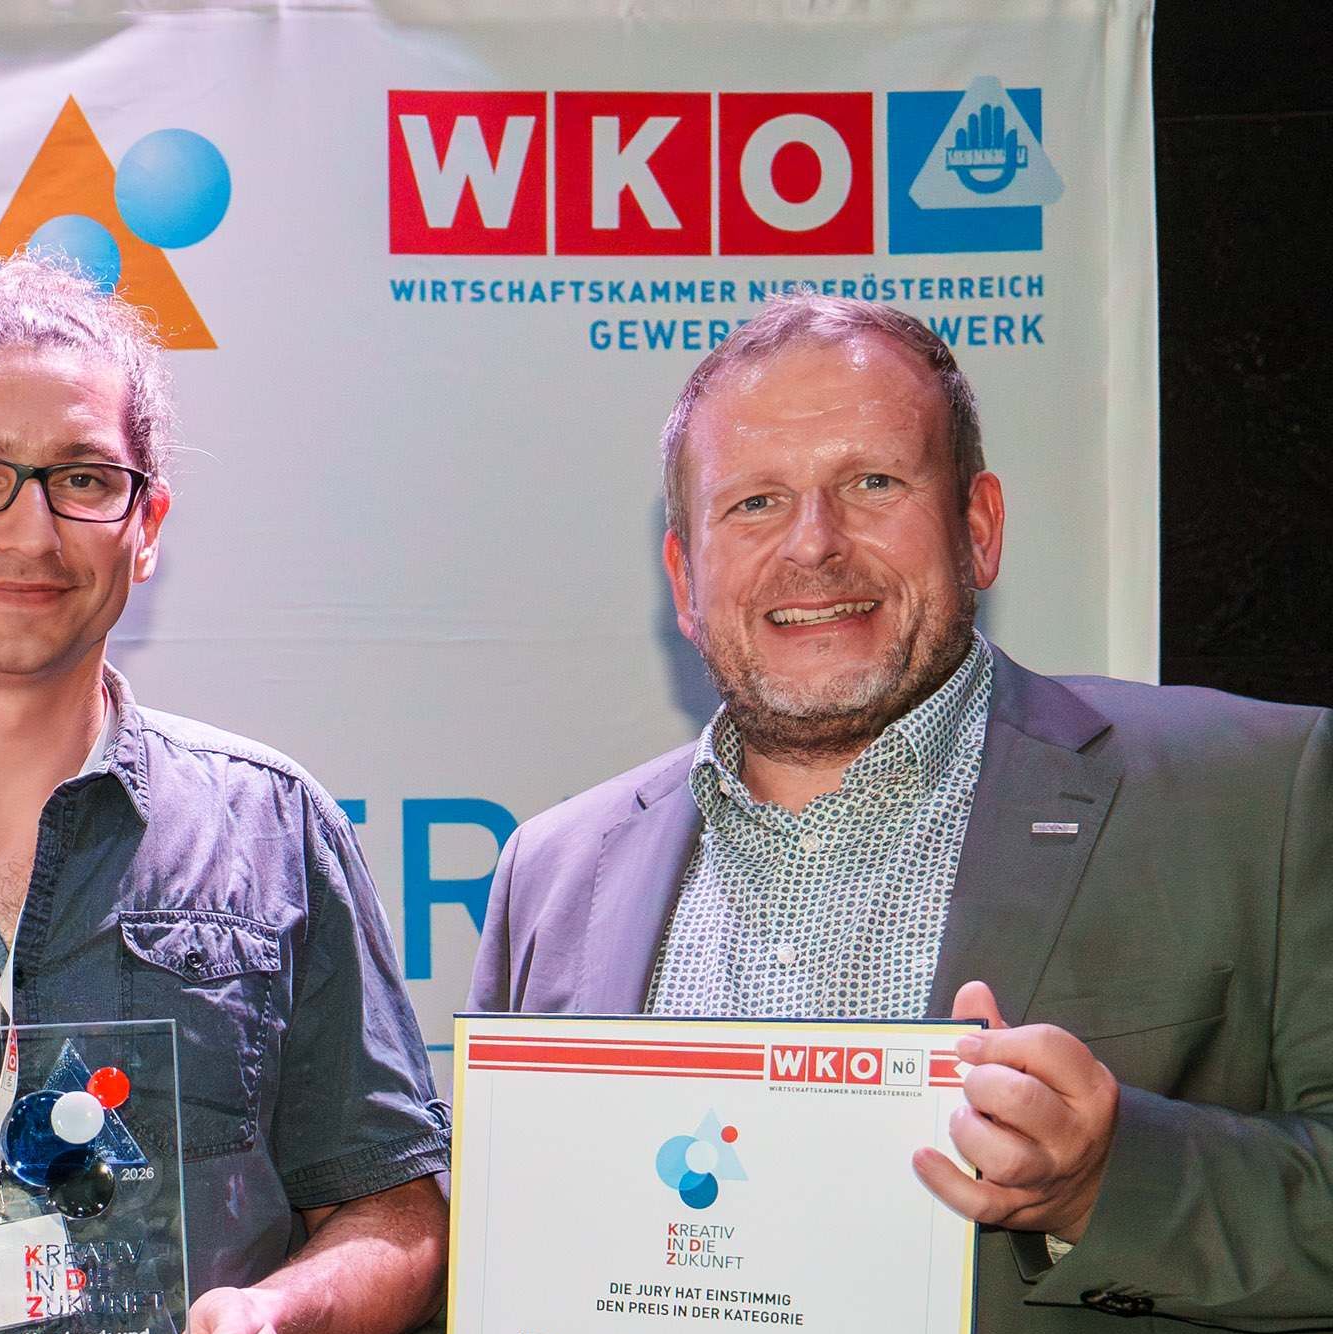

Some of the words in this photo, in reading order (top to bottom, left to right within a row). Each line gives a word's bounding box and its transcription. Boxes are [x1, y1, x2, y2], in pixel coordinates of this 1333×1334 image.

[398, 112, 853, 232] WKO
[390, 279, 735, 303] WIRTSCHAFTSKAMMER
[773, 1050, 878, 1080] WKO
[893, 1057, 915, 1075] NÖ
[769, 1086, 848, 1094] WIRTSCHAFTSKAMMER
[121, 1167, 154, 1181] 2026
[668, 1223, 734, 1239] KREATIV
[25, 1239, 144, 1267] KREATIV
[667, 1238, 684, 1251] IN
[689, 1239, 716, 1253] DIE
[666, 1252, 744, 1270] ZUKUNFT
[26, 1270, 54, 1292] IN
[66, 1268, 111, 1290] DIE
[26, 1290, 164, 1318] ZUKUNFT
[610, 1282, 632, 1295] DIE
[635, 1285, 672, 1298] JURY
[675, 1287, 702, 1300] HAT
[706, 1289, 791, 1306] EINSTIMMIG
[596, 1299, 624, 1313] DEN
[628, 1302, 669, 1316] PREIS
[673, 1305, 687, 1318] IN
[692, 1306, 720, 1320] DER
[724, 1308, 804, 1326] KATEGORIE
